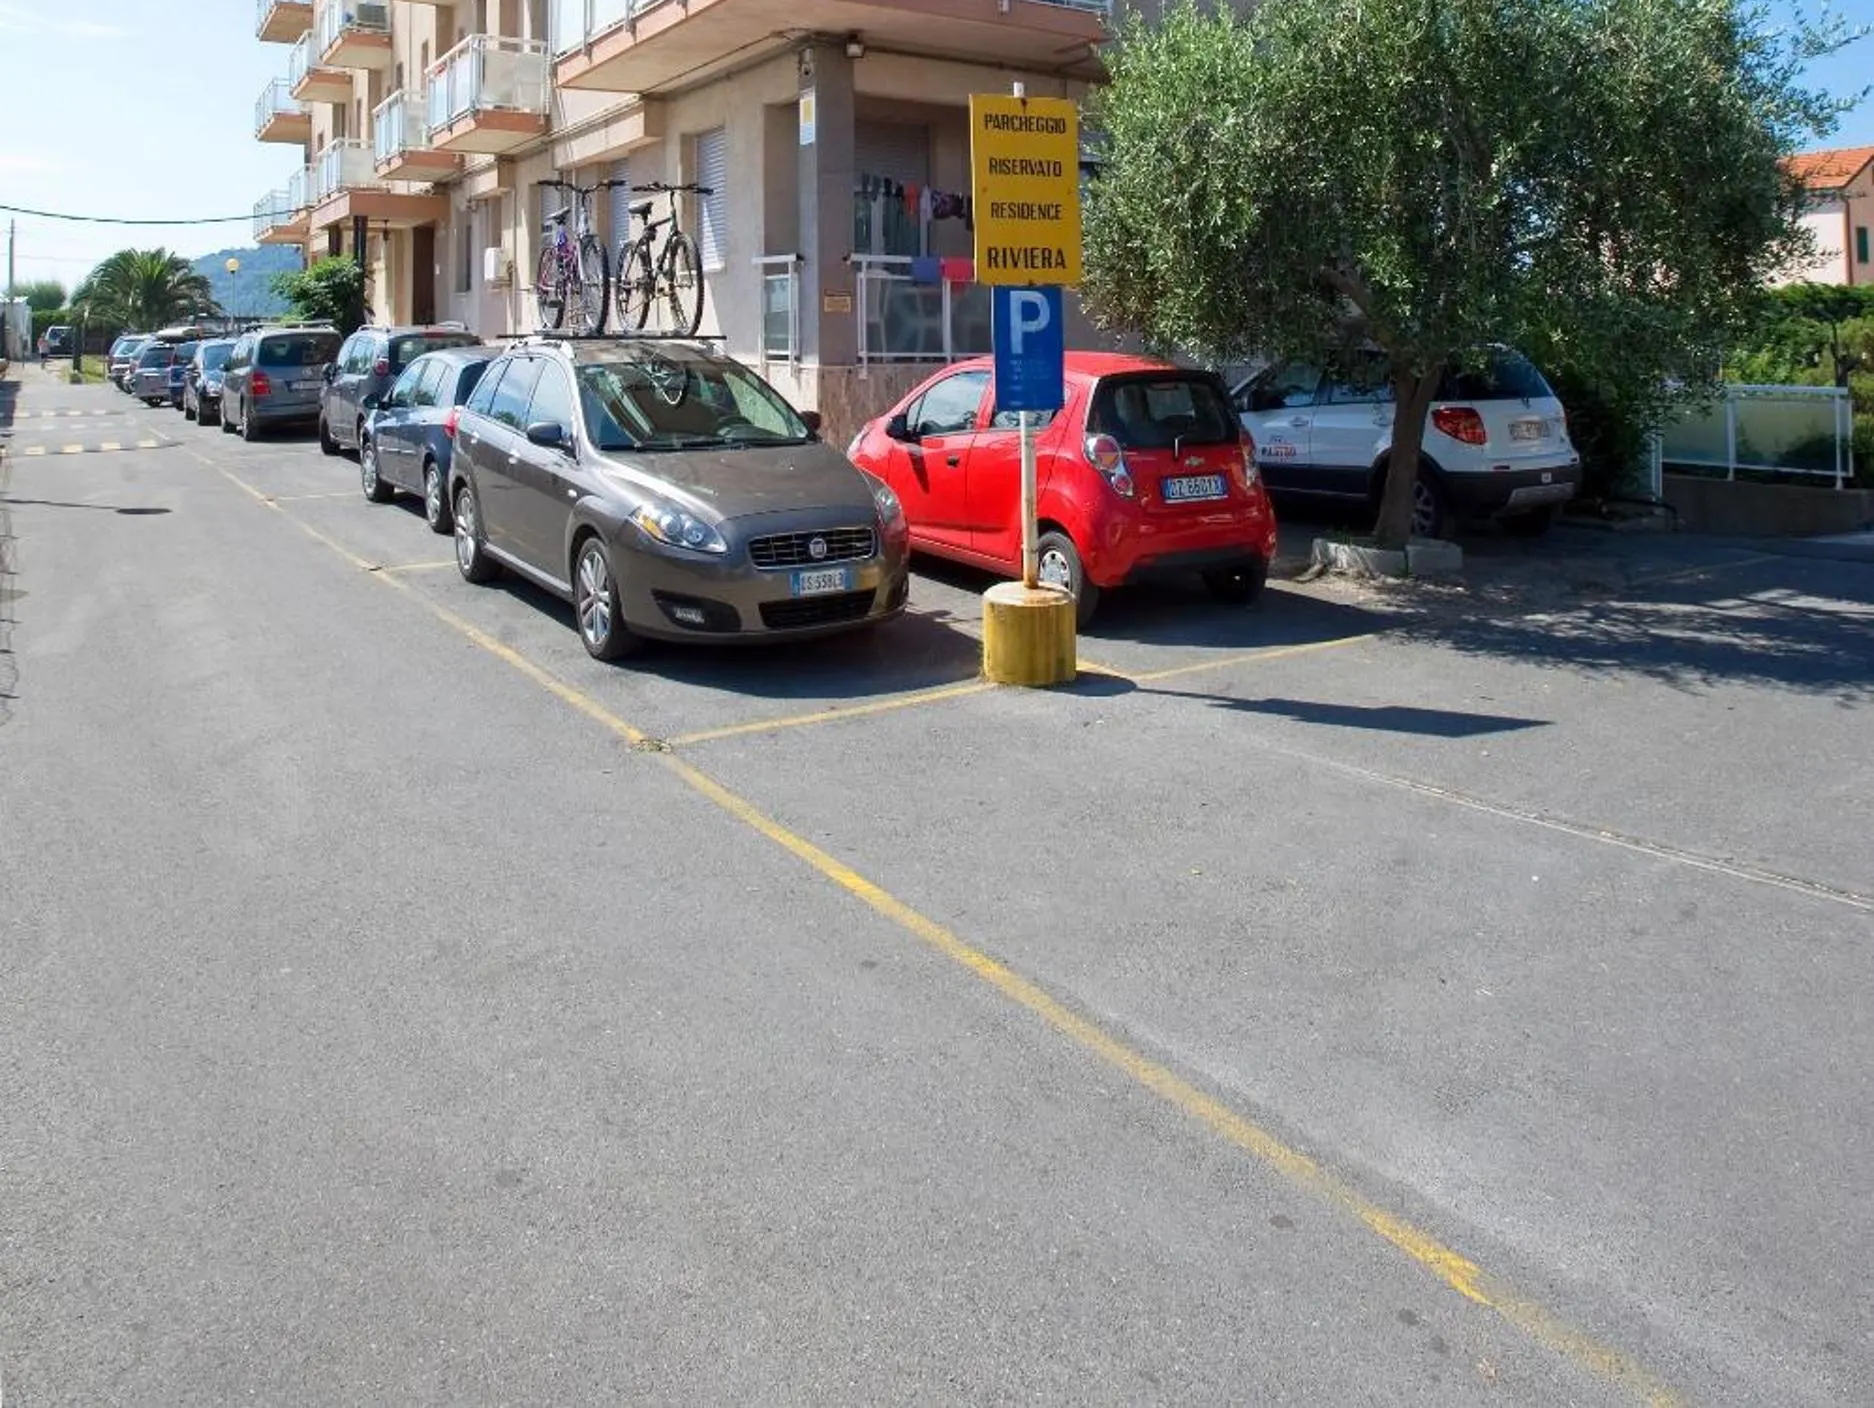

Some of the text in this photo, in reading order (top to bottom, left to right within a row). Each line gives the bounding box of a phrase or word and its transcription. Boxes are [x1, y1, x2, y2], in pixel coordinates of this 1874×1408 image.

[983, 112, 1067, 135] PARCHEGGIO
[988, 155, 1063, 178] RISERVATO
[990, 201, 1063, 221] RESIDENCE
[986, 245, 1068, 270] RIVIERA
[1008, 290, 1051, 355] P
